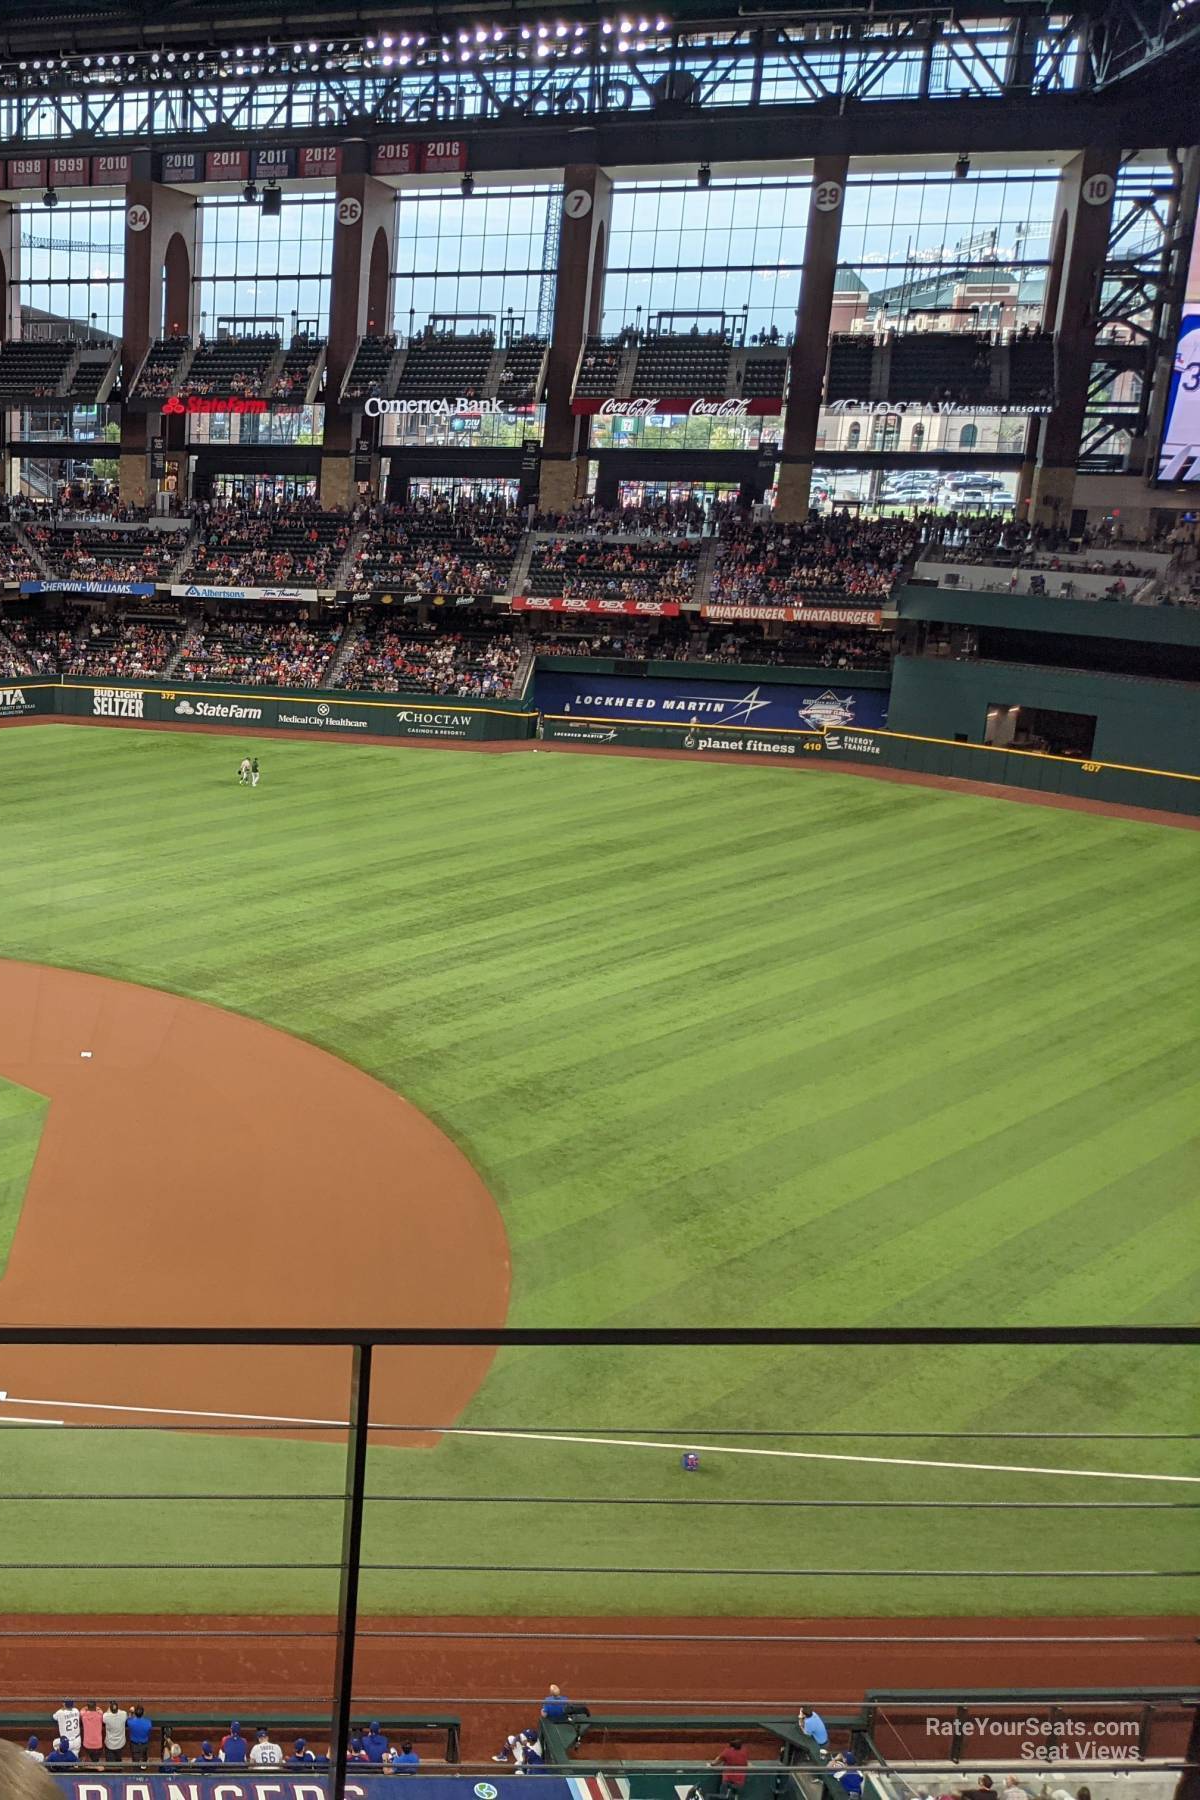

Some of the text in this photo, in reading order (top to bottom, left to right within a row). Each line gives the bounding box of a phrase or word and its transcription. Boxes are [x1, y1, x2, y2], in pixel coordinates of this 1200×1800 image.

[305, 148, 336, 162] 2012
[378, 144, 408, 159] 2015
[427, 142, 459, 157] 2016
[99, 156, 127, 170] 2010
[166, 154, 194, 167] 2010
[213, 152, 240, 166] 2011
[259, 150, 287, 164] 2011
[13, 160, 41, 173] 1998
[54, 158, 83, 172] 1999
[816, 188, 839, 204] 29
[1089, 181, 1106, 197] 10
[572, 196, 584, 212] 7
[129, 210, 147, 225] 34
[340, 204, 358, 219] 26
[1182, 362, 1200, 392] 3
[455, 397, 504, 416] Bank
[600, 398, 660, 416] Coca-Cola
[689, 398, 752, 416] Coca-Cola
[843, 399, 957, 415] CHOCTAW
[957, 405, 998, 413] CASINOS
[1010, 405, 1052, 413] RESORTS
[201, 588, 245, 598] Albertsons
[525, 598, 552, 606] DEX
[561, 599, 588, 607] DEX
[598, 600, 625, 609] DEX
[636, 602, 663, 610] DEX
[706, 605, 785, 619] WHATABURGER
[793, 609, 875, 624] WHATABURGER
[94, 689, 143, 699] BUD LIGHT
[93, 697, 144, 718] SELTZER
[576, 695, 725, 713] LOCKHEED MARTIN
[278, 714, 367, 728] Medical City Healthcare
[404, 711, 472, 726] CHOCTAW
[697, 738, 795, 753] planet fitness
[803, 742, 822, 751] 410
[844, 736, 874, 746] ENERGY
[844, 743, 880, 754] TRANSFER
[1082, 763, 1101, 773] 407
[65, 1718, 79, 1732] 23
[261, 1751, 276, 1763] 66
